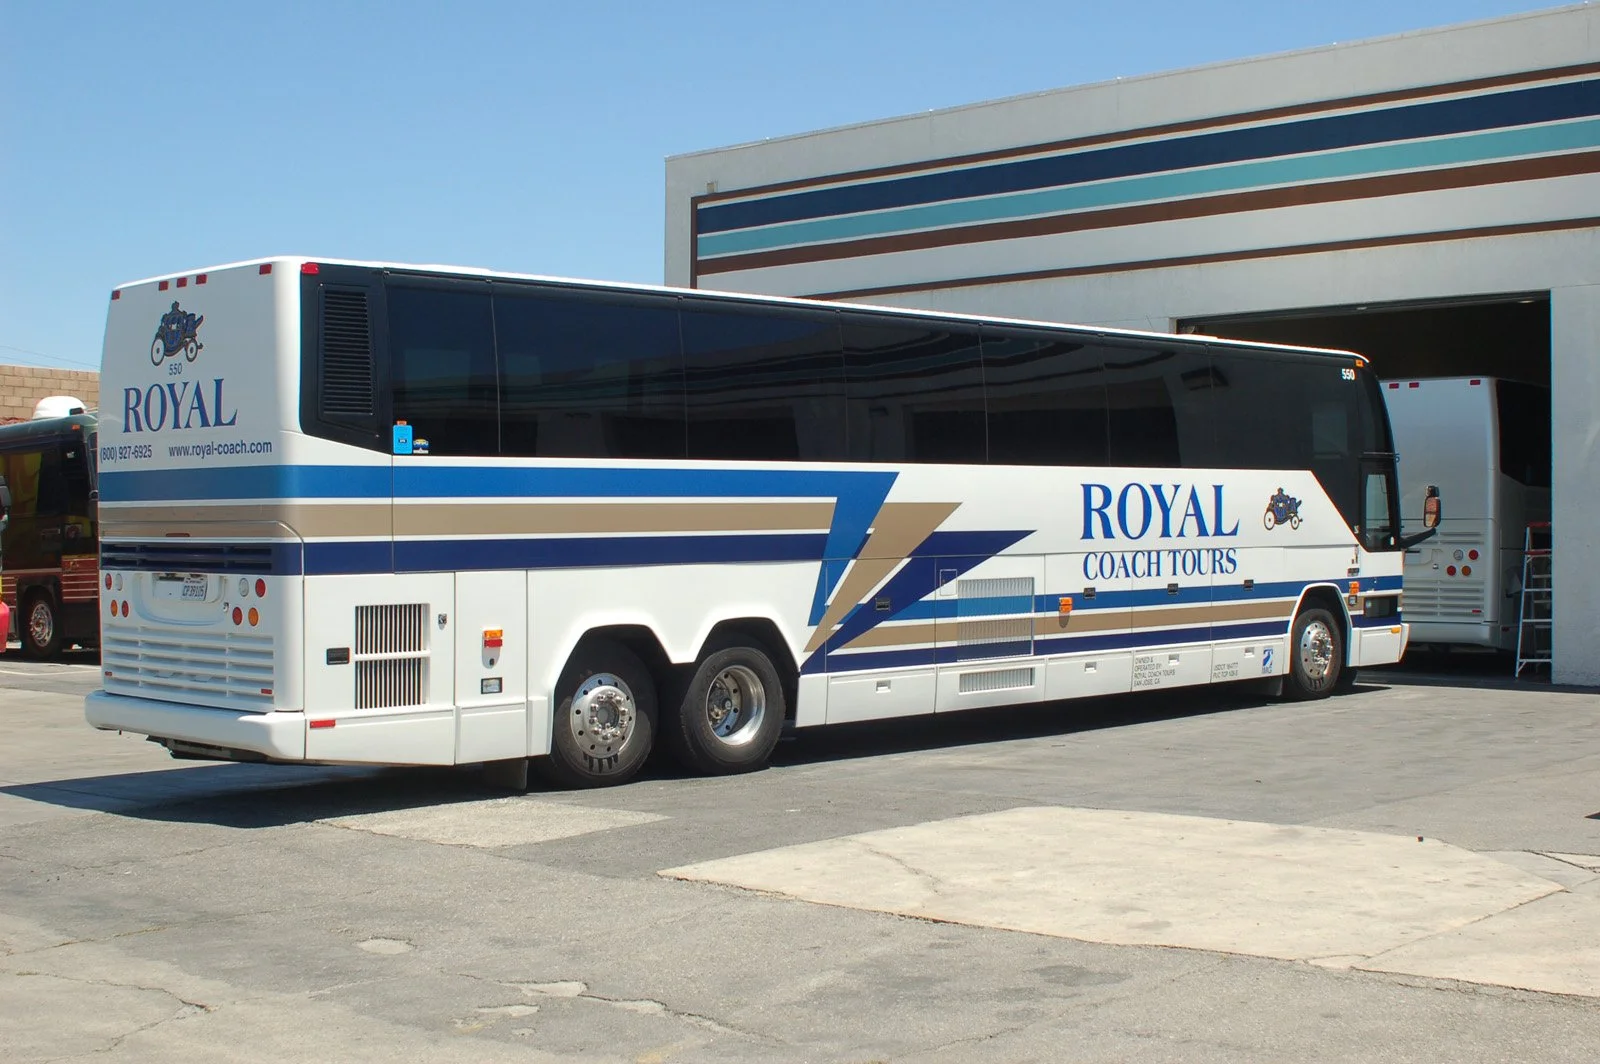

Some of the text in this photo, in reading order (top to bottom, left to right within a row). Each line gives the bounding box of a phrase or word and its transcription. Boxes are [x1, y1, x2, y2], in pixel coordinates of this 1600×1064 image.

[169, 363, 182, 375] 550
[1341, 368, 1355, 381] 550
[122, 378, 238, 433] ROYAL
[99, 444, 153, 463] (800) 927-6925
[168, 440, 272, 460] www.royal-coach.com
[1080, 482, 1239, 540] ROYAL
[1083, 547, 1237, 580] COACH TOURS
